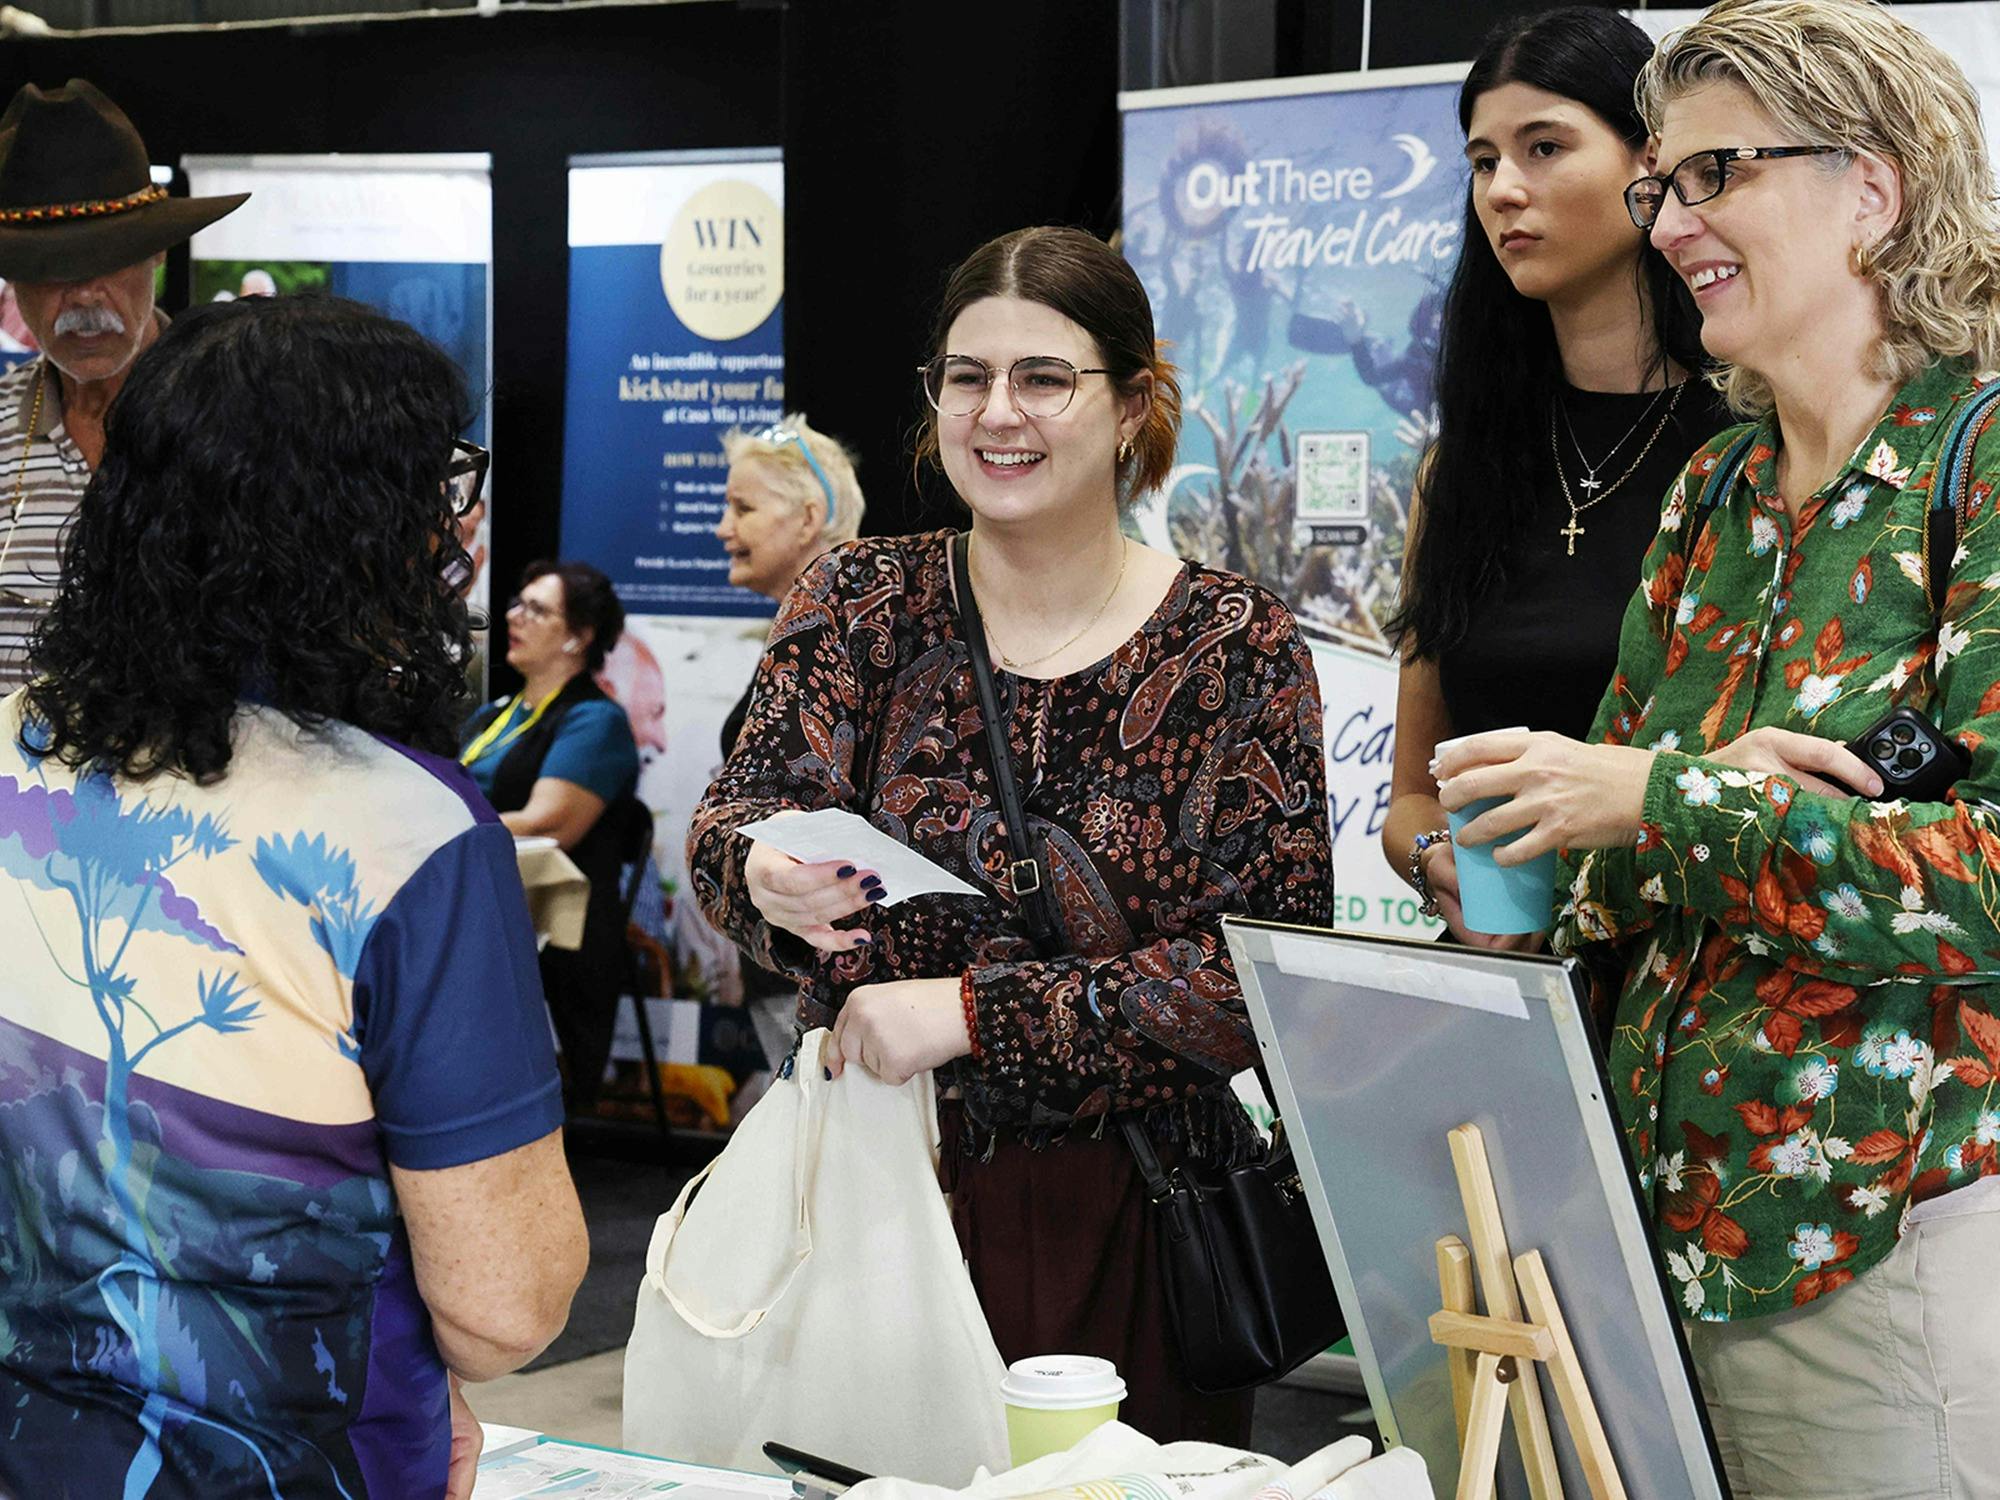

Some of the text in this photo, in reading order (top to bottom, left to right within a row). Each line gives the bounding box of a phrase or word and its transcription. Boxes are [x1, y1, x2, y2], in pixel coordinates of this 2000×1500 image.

[1186, 158, 1373, 210] OutThere
[693, 216, 765, 250] WIN
[1243, 207, 1458, 274] Travel Care
[685, 284, 707, 302] for
[712, 289, 722, 302] a
[629, 353, 651, 370] An
[651, 352, 718, 371] incredible
[618, 375, 709, 401] kickstart
[711, 382, 761, 405] your
[678, 406, 710, 424] Casa
[1332, 706, 1394, 765] Ca
